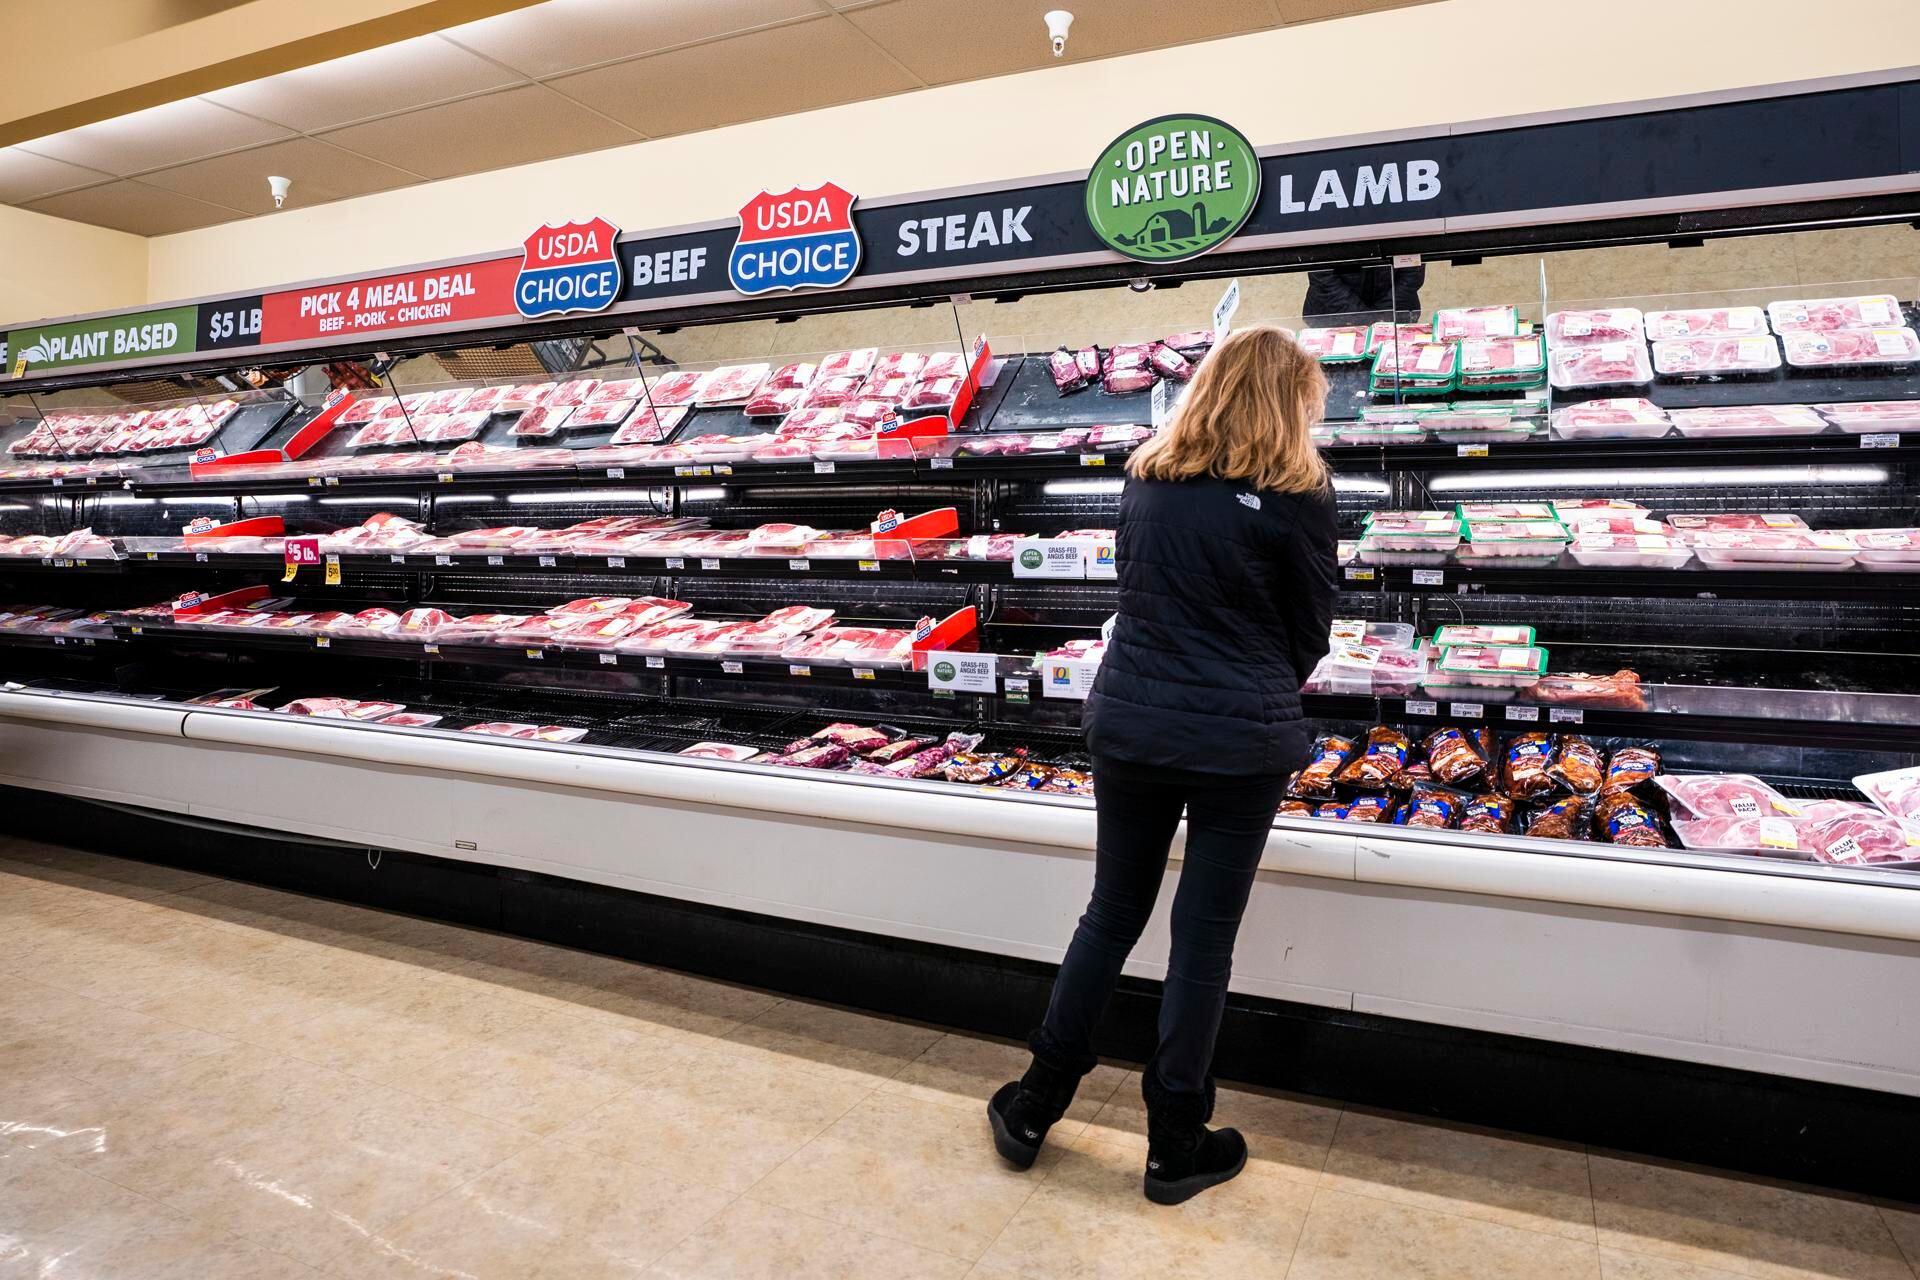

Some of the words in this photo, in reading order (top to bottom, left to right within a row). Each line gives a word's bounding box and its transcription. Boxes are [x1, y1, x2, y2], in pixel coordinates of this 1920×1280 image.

[1126, 131, 1212, 173] OPEN
[1111, 160, 1233, 207] NATURE
[1280, 159, 1442, 214] LAMB
[756, 196, 833, 232] USDA
[897, 206, 1032, 256] STEAK
[537, 231, 599, 260] USDA
[737, 243, 850, 280] CHOICE
[633, 247, 707, 286] BEEF
[300, 294, 341, 318] PICK
[346, 291, 359, 313] 4
[364, 282, 418, 311] MEAL
[424, 273, 476, 299] DEAL
[521, 270, 613, 304] CHOICE
[210, 311, 234, 340] $5
[239, 310, 262, 336] LB
[319, 317, 346, 332] BEEF
[354, 311, 388, 327] PORK
[397, 303, 452, 321] CHICKEN
[50, 331, 109, 361] PLANT
[114, 322, 178, 354] BASED
[880, 521, 896, 532] CHOICE
[288, 543, 302, 561] $5
[304, 547, 316, 560] lb.
[1831, 839, 1853, 853] VALUE
[1835, 845, 1856, 856] PACK
